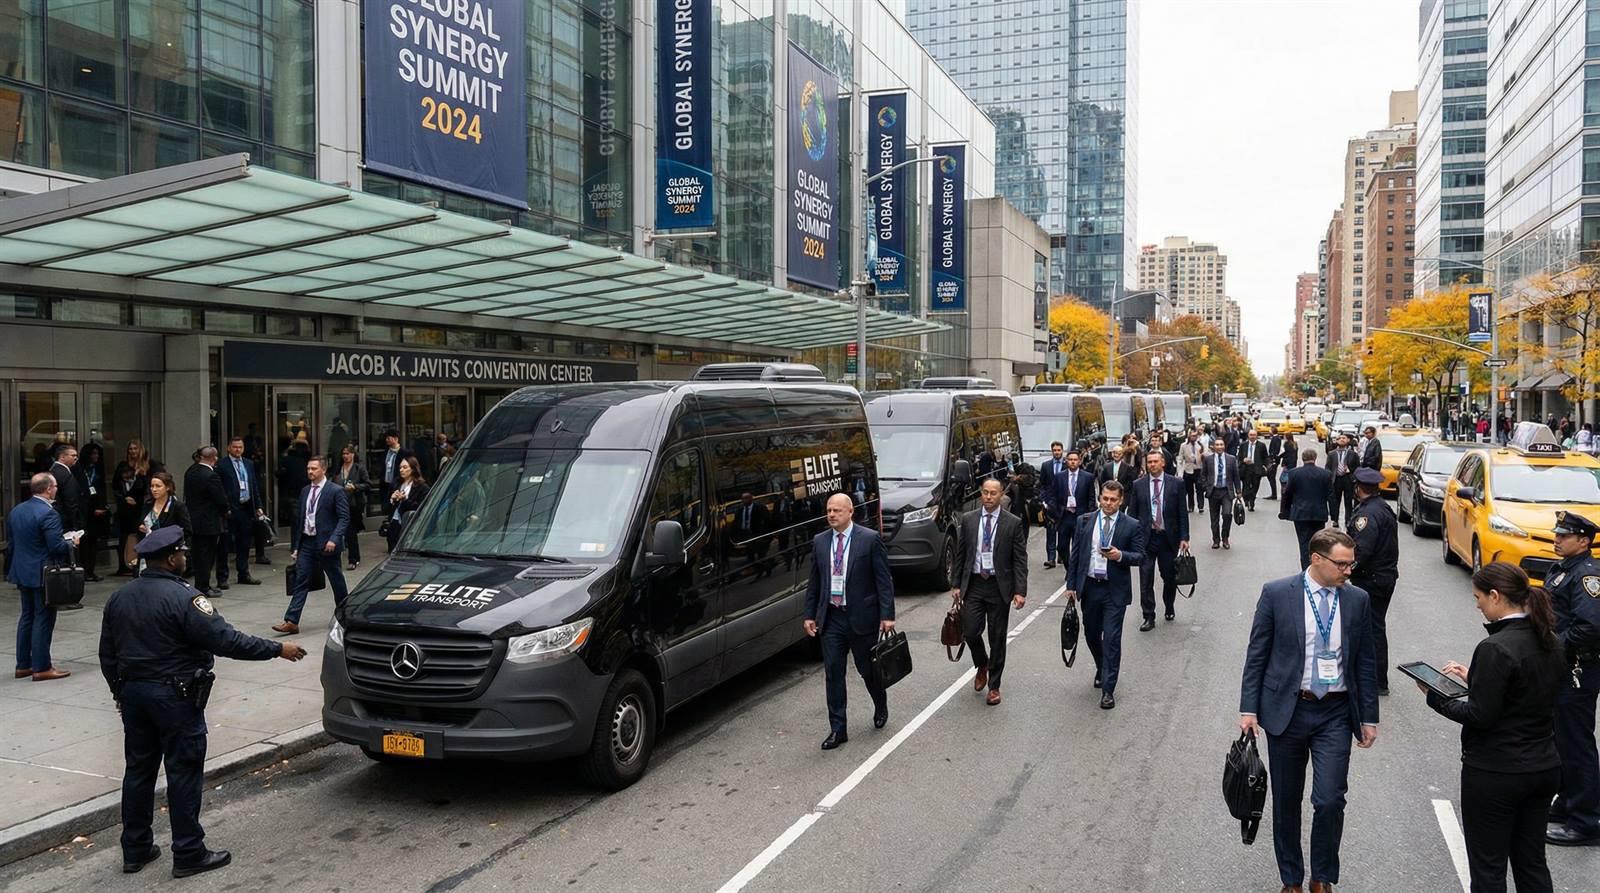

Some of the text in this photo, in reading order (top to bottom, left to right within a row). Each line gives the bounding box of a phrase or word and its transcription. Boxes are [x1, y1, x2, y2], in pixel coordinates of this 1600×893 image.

[408, 0, 500, 41] OBAL
[390, 4, 508, 79] SYNERGY
[399, 48, 502, 113] SUMMIT
[421, 97, 482, 144] 2024
[675, 76, 692, 150] GLOBAL
[665, 186, 704, 196] SYNERGY
[668, 177, 701, 187] GLOBAL
[797, 169, 831, 200] GLOBAL
[880, 133, 893, 240] GLOBAL SYNERGY
[667, 195, 702, 205] SUMMIT
[674, 204, 695, 214] 2024
[794, 189, 833, 221] SYNERGY
[797, 212, 831, 240] SUMMIT
[943, 177, 953, 268] GLOBAL SYNERGY
[803, 236, 825, 260] 2024
[326, 352, 593, 383] JACOB K. JAVITS CONVENTION CENTER
[803, 453, 841, 481] ELITE
[806, 477, 842, 497] TRANSPORT
[411, 594, 489, 610] TRANSPORT
[418, 583, 501, 602] ELITE
